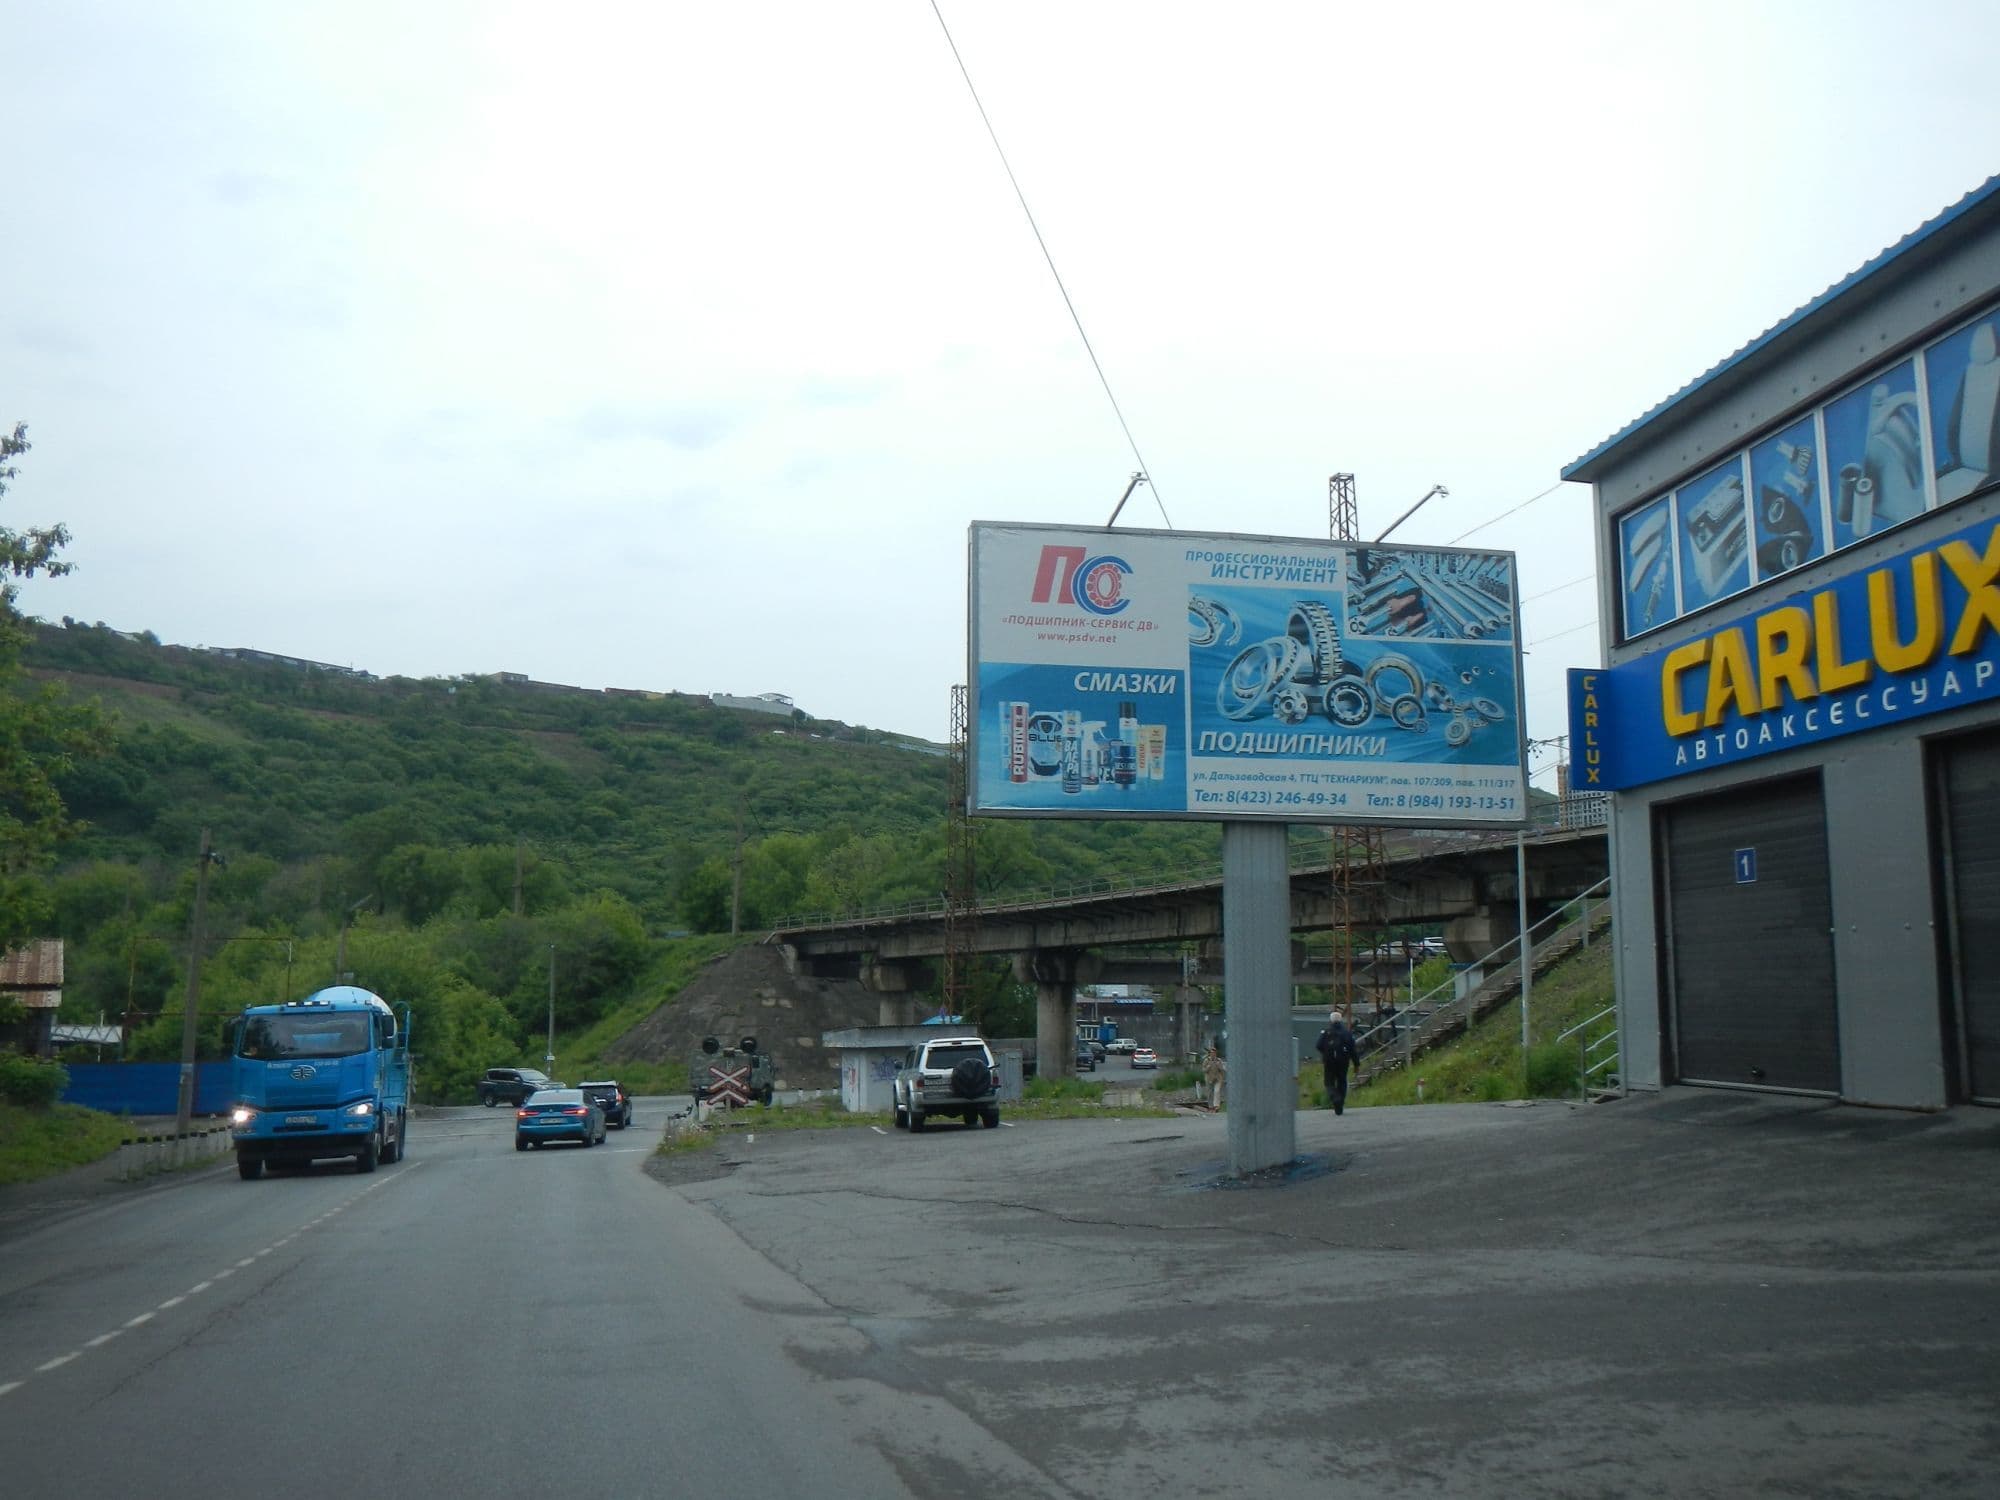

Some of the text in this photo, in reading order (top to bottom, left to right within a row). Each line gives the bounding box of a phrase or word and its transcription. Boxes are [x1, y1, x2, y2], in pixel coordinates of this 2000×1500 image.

[1185, 550, 1337, 569] ПРОФЕССИОНАЛЬНЫЙ
[1210, 563, 1338, 584] ИНСТРУМЕНТ
[1037, 632, 1117, 643] www.psdv.net
[1662, 522, 2000, 737] CARLUX
[1074, 671, 1177, 694] СМАЗКИ
[1675, 660, 1993, 766] АВТОАКСЕССУАР
[1583, 676, 1600, 783] CARLUX
[1199, 731, 1387, 756] ПОДШИПНИКИ
[1300, 773, 1319, 784] ТТЦ
[1195, 789, 1515, 810] Тел: 8(423) 246-49-34 Тел: 8 (984) 193-13-51
[1741, 855, 1748, 876] 1
